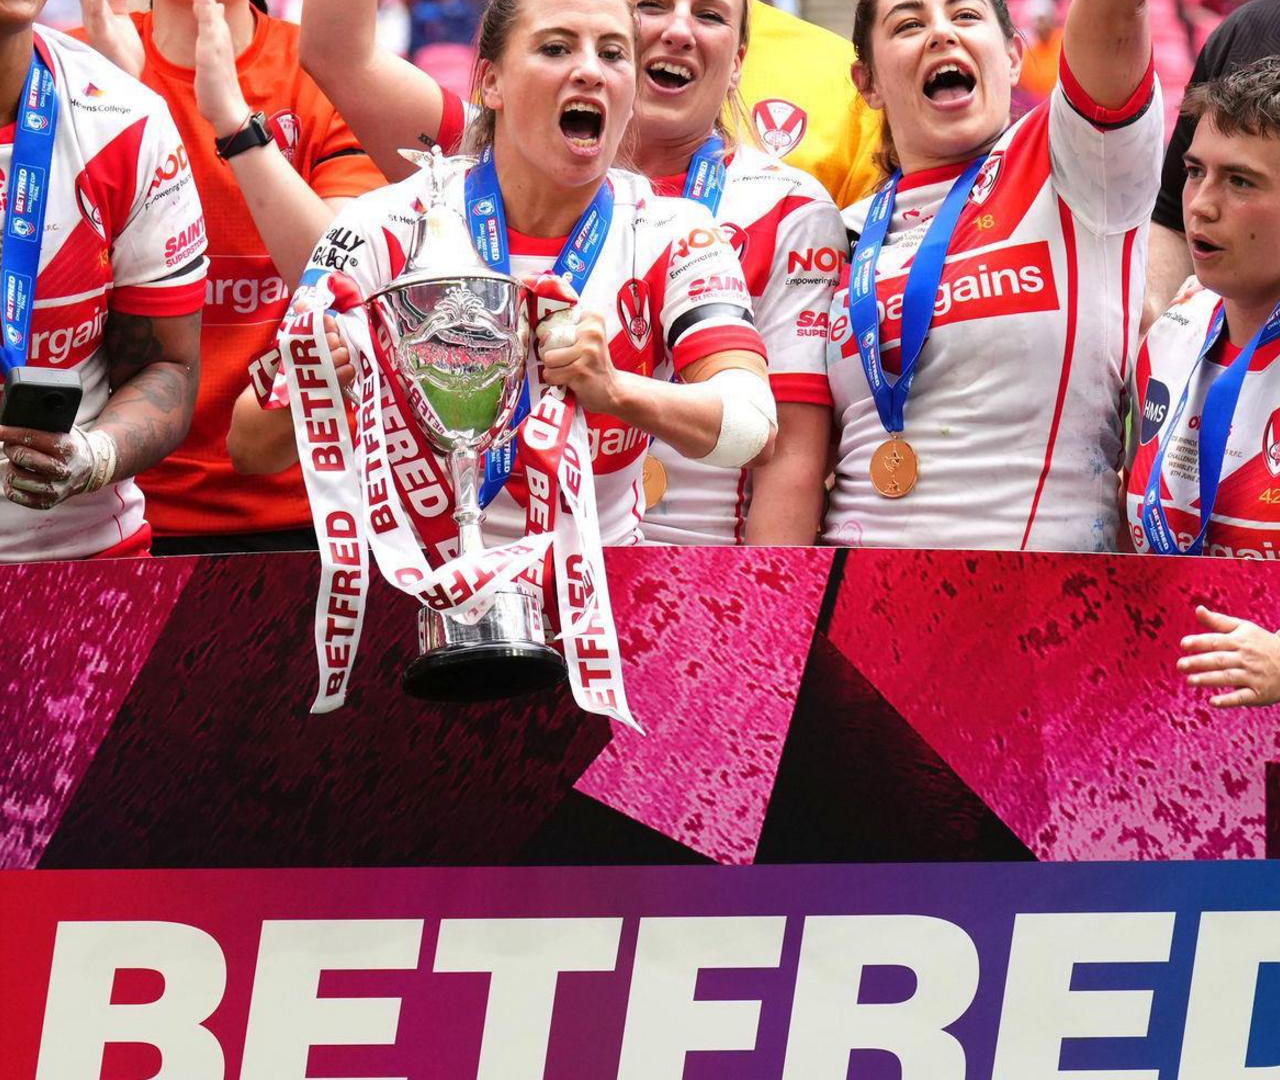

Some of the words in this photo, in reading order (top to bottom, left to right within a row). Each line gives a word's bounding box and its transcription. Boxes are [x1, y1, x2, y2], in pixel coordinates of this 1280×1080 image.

[28, 68, 41, 108] BETFRED
[15, 168, 28, 213] BETFRED
[692, 161, 708, 197] BETFRED
[488, 219, 500, 261] BETFRED
[574, 210, 597, 250] BETFRED
[974, 214, 995, 231] 18
[6, 275, 16, 320] BETFRED
[877, 263, 1045, 322] agains
[289, 312, 346, 472] BETFRE
[1144, 399, 1167, 423] HMS
[357, 350, 400, 535] BETFRED
[1152, 508, 1170, 550] BETFRED
[325, 510, 362, 696] BETFRED
